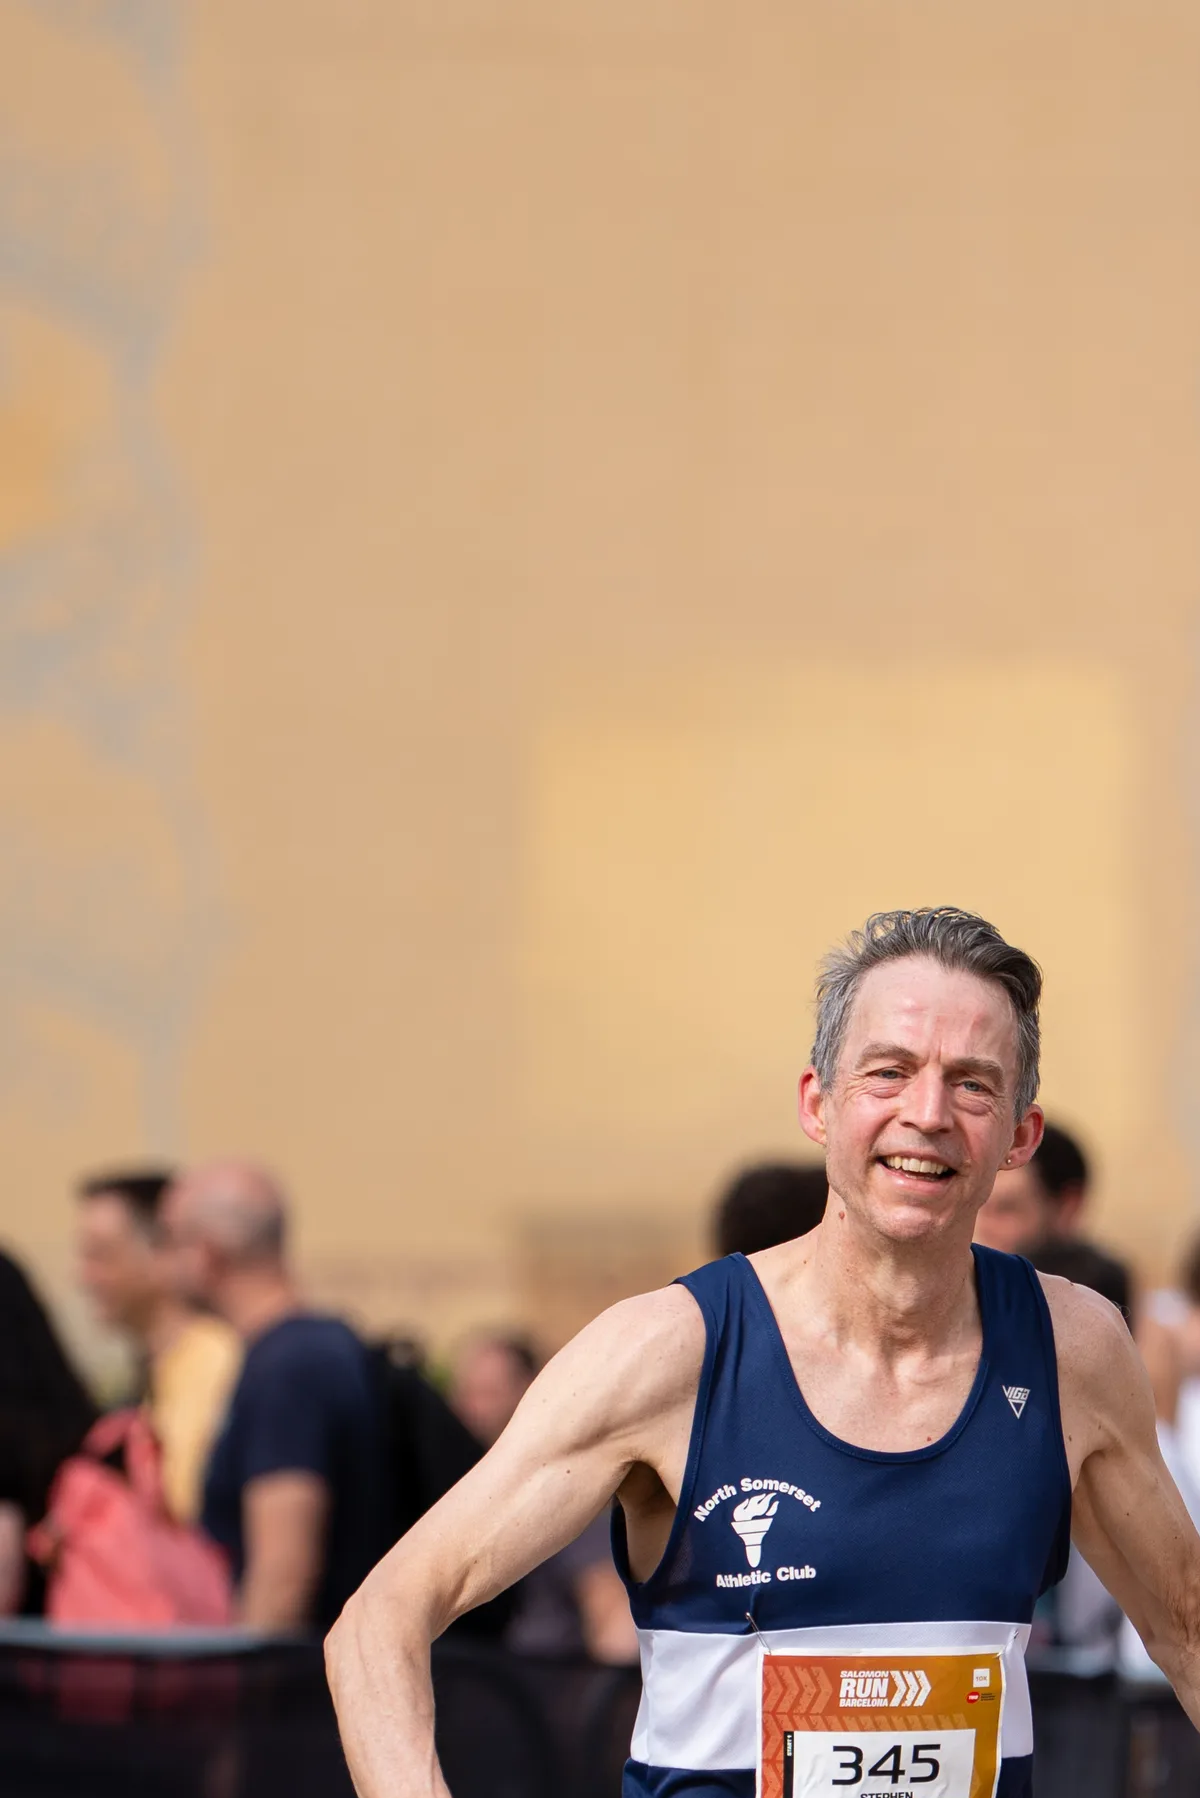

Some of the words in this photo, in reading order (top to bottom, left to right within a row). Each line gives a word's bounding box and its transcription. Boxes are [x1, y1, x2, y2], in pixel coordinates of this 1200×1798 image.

[693, 1484, 738, 1522] North
[740, 1477, 822, 1512] Somerset
[716, 1570, 772, 1588] Athletic
[776, 1564, 817, 1581] Club
[840, 1670, 889, 1678] SALOMON
[839, 1678, 889, 1698] RUN
[839, 1698, 889, 1707] BARCELONA
[831, 1743, 941, 1786] 345
